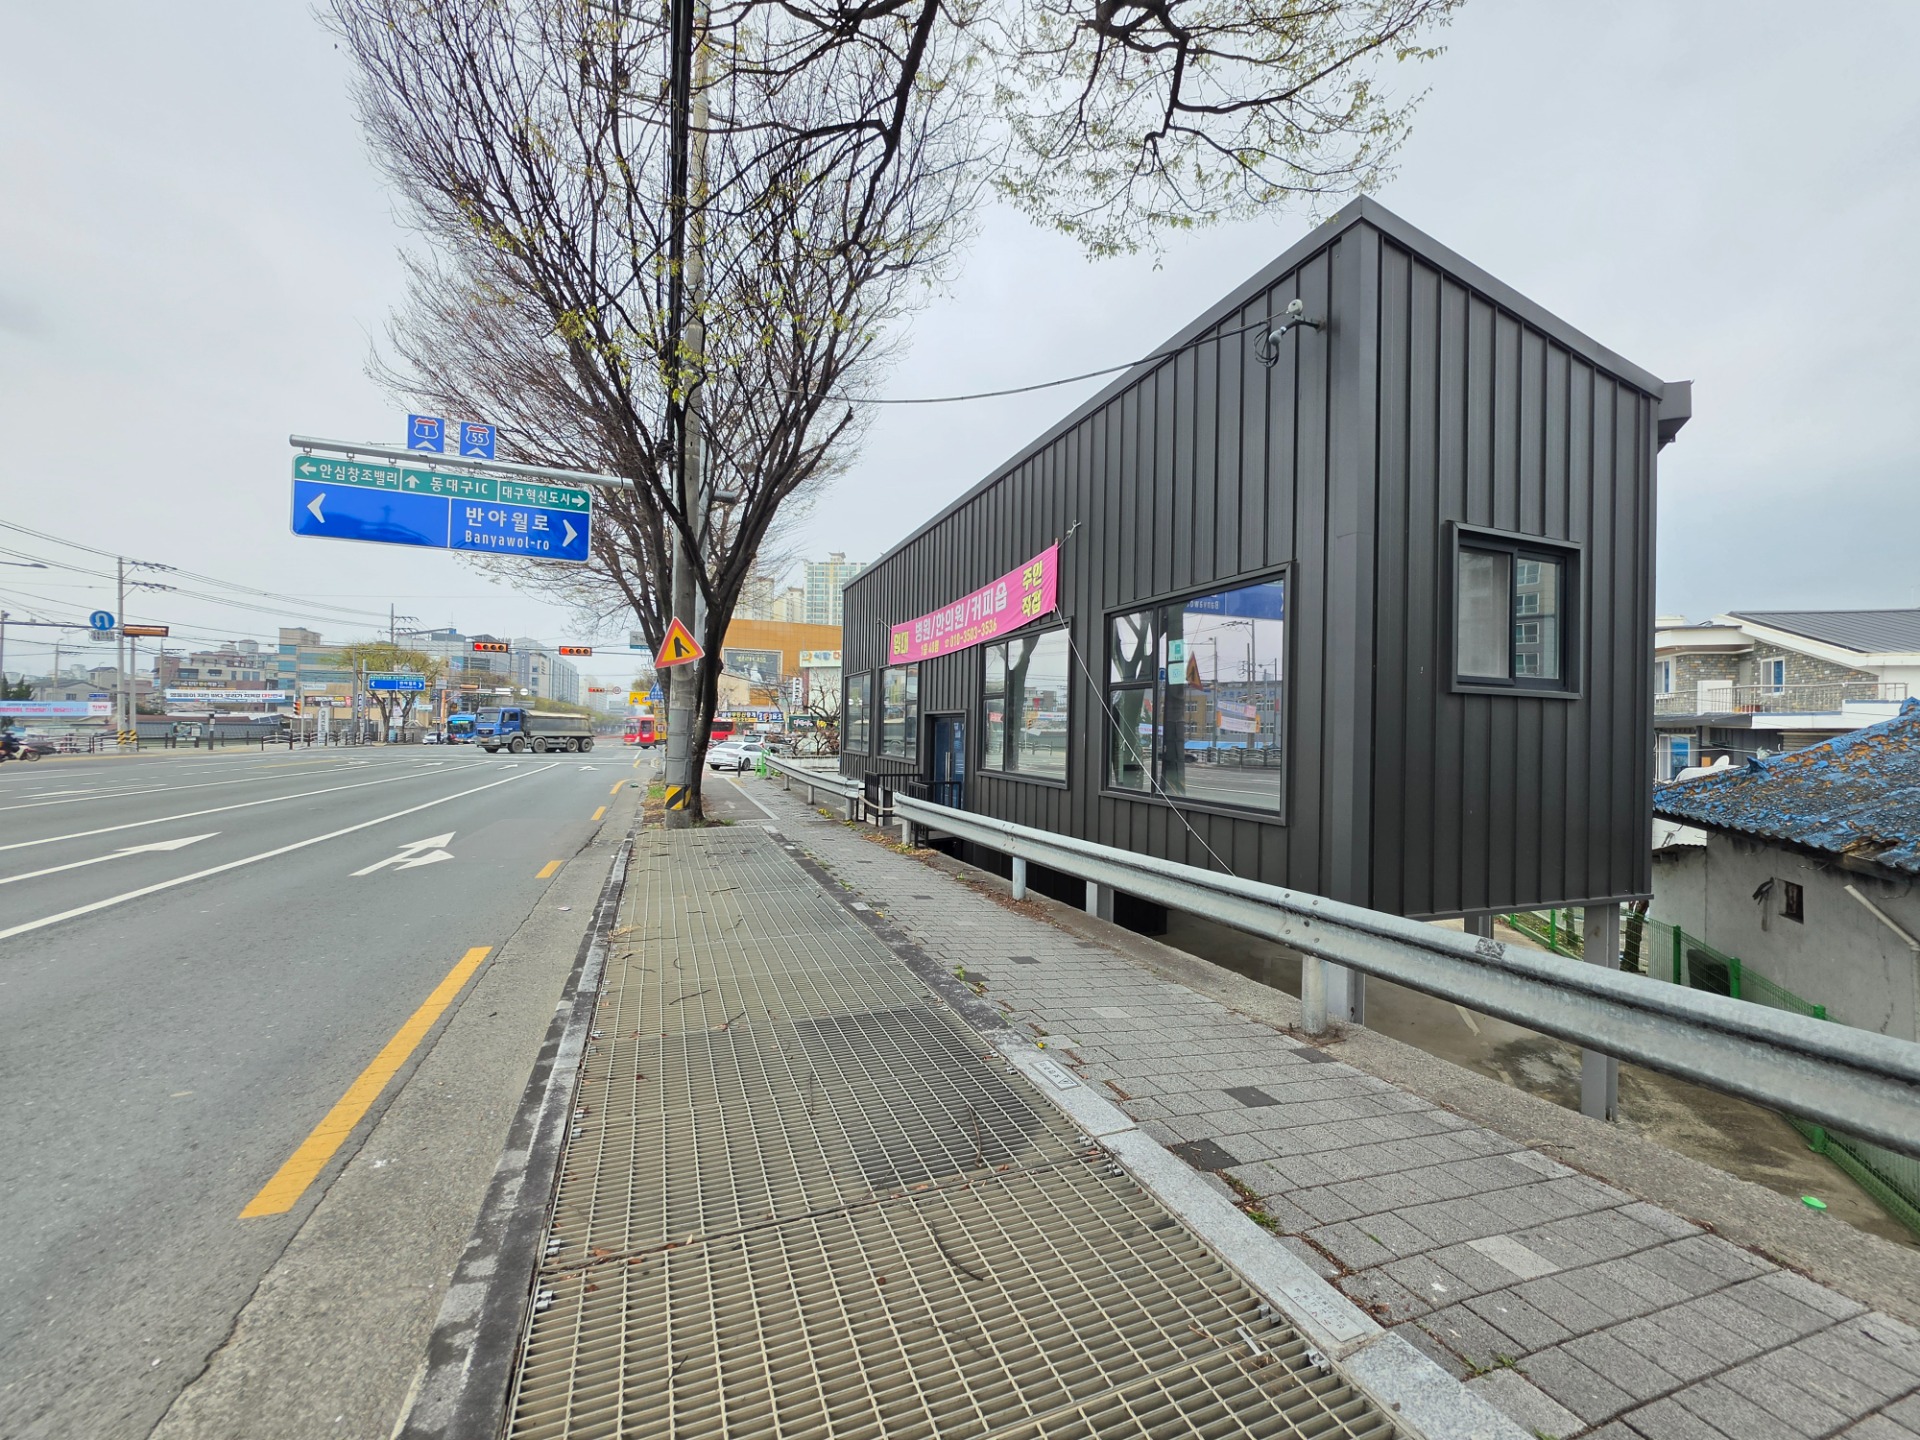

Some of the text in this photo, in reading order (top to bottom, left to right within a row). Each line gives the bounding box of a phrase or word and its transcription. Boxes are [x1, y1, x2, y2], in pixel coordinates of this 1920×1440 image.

[422, 425, 429, 437] 1
[471, 432, 485, 443] 55
[319, 464, 398, 486] 안심창조밸리
[429, 476, 488, 494] 동대구IC
[502, 486, 570, 505] 대구혁신도시
[465, 507, 550, 533] 반야월로
[465, 530, 550, 551] Banyawol-ro
[1022, 560, 1043, 592] 주인
[915, 581, 1008, 644] 병원/한의원/커피숍
[1021, 588, 1043, 618] 직접
[893, 631, 909, 656] 임대
